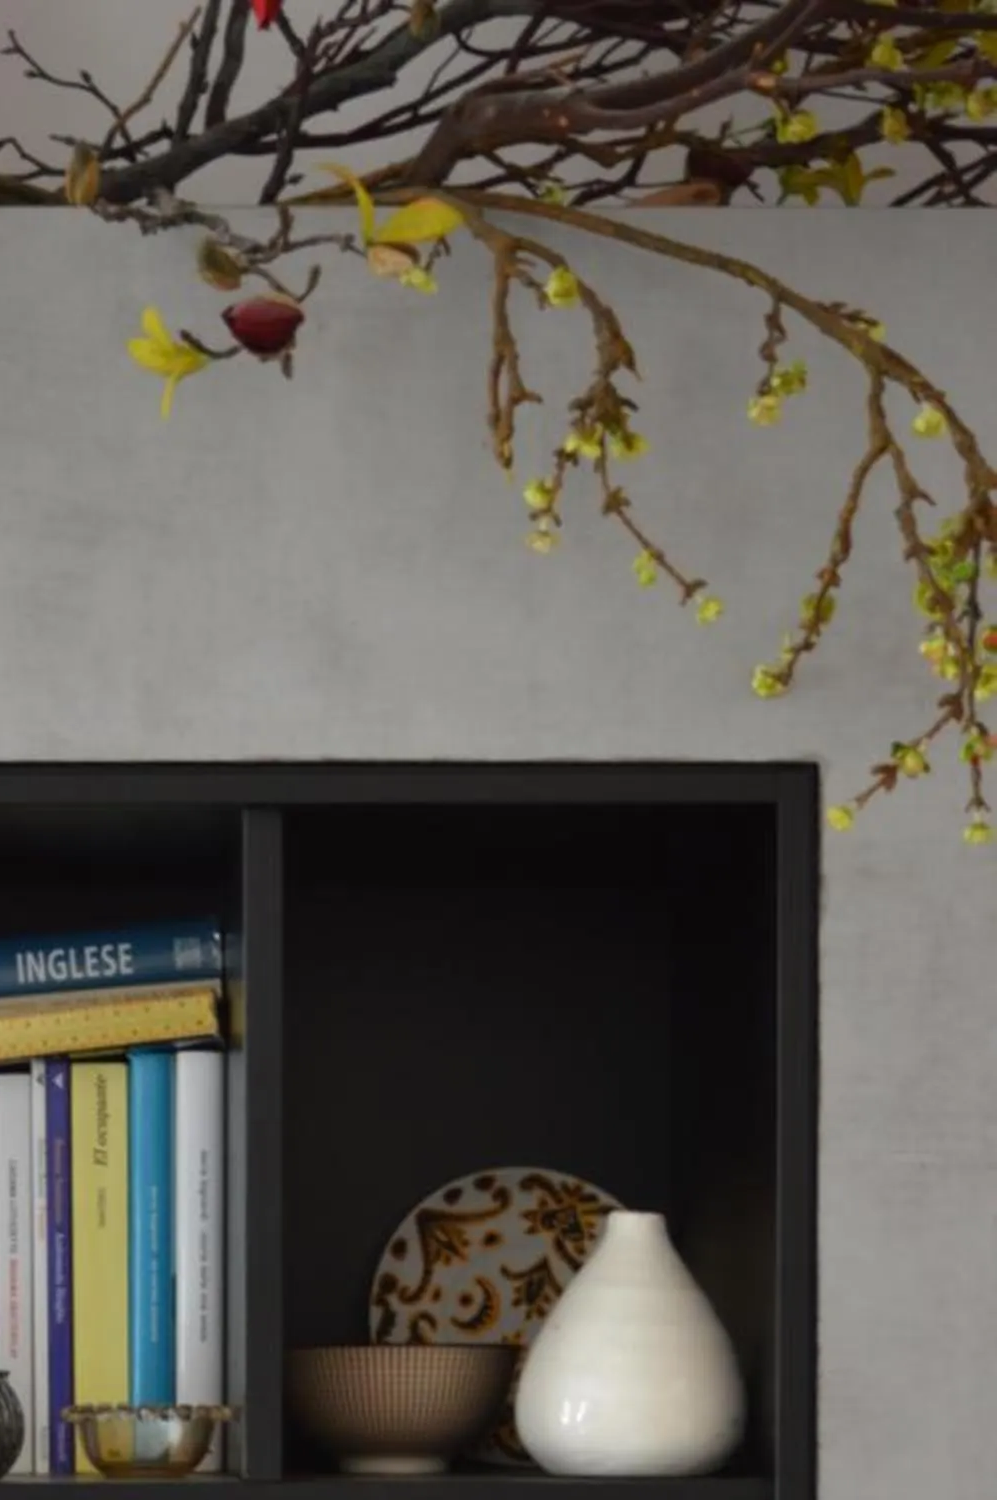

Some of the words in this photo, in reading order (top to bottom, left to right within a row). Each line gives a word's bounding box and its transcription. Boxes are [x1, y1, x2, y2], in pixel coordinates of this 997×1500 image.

[15, 941, 135, 985] INGLESE
[91, 1073, 112, 1146] ocupante
[92, 1147, 108, 1167] El
